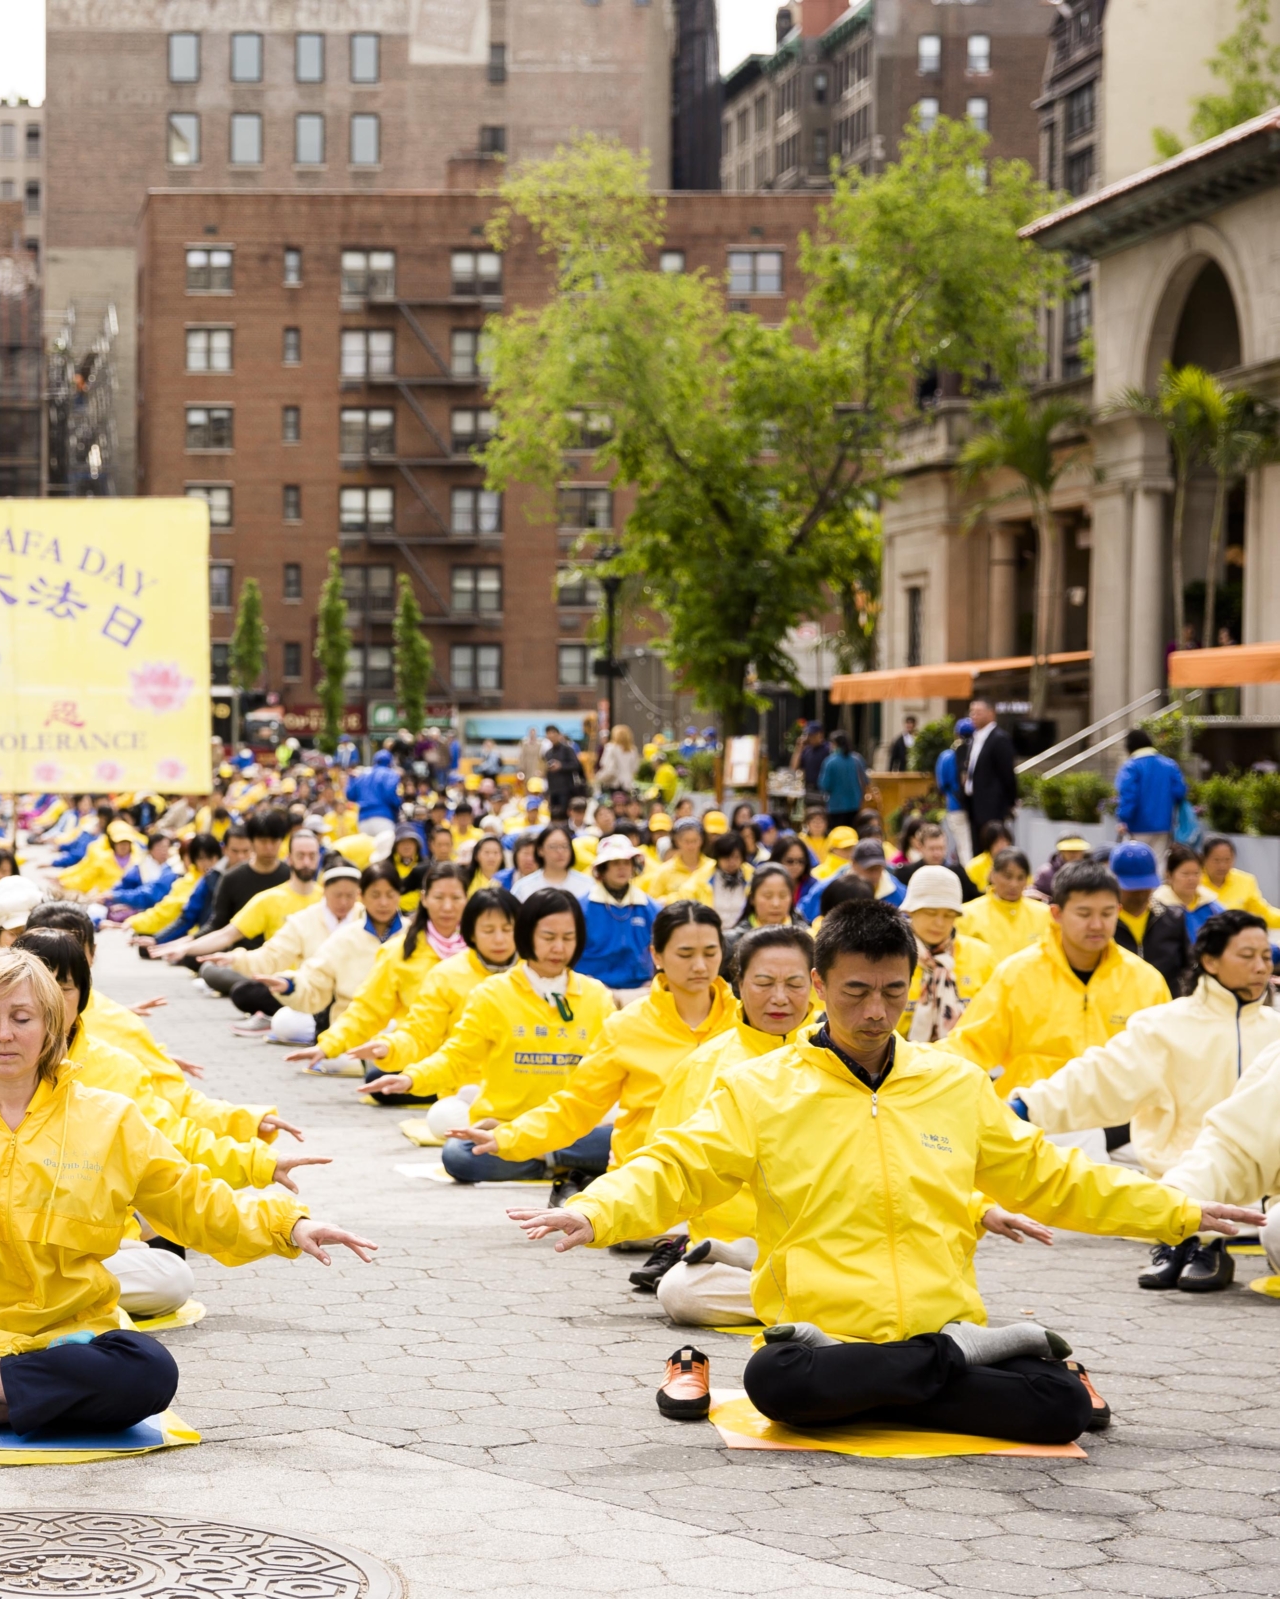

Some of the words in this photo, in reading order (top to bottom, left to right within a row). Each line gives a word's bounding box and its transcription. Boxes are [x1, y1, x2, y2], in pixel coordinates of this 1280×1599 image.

[79, 546, 158, 599] DAY
[44, 700, 86, 728] 忍
[516, 1054, 553, 1065] FALUN
[937, 1143, 952, 1153] Gong
